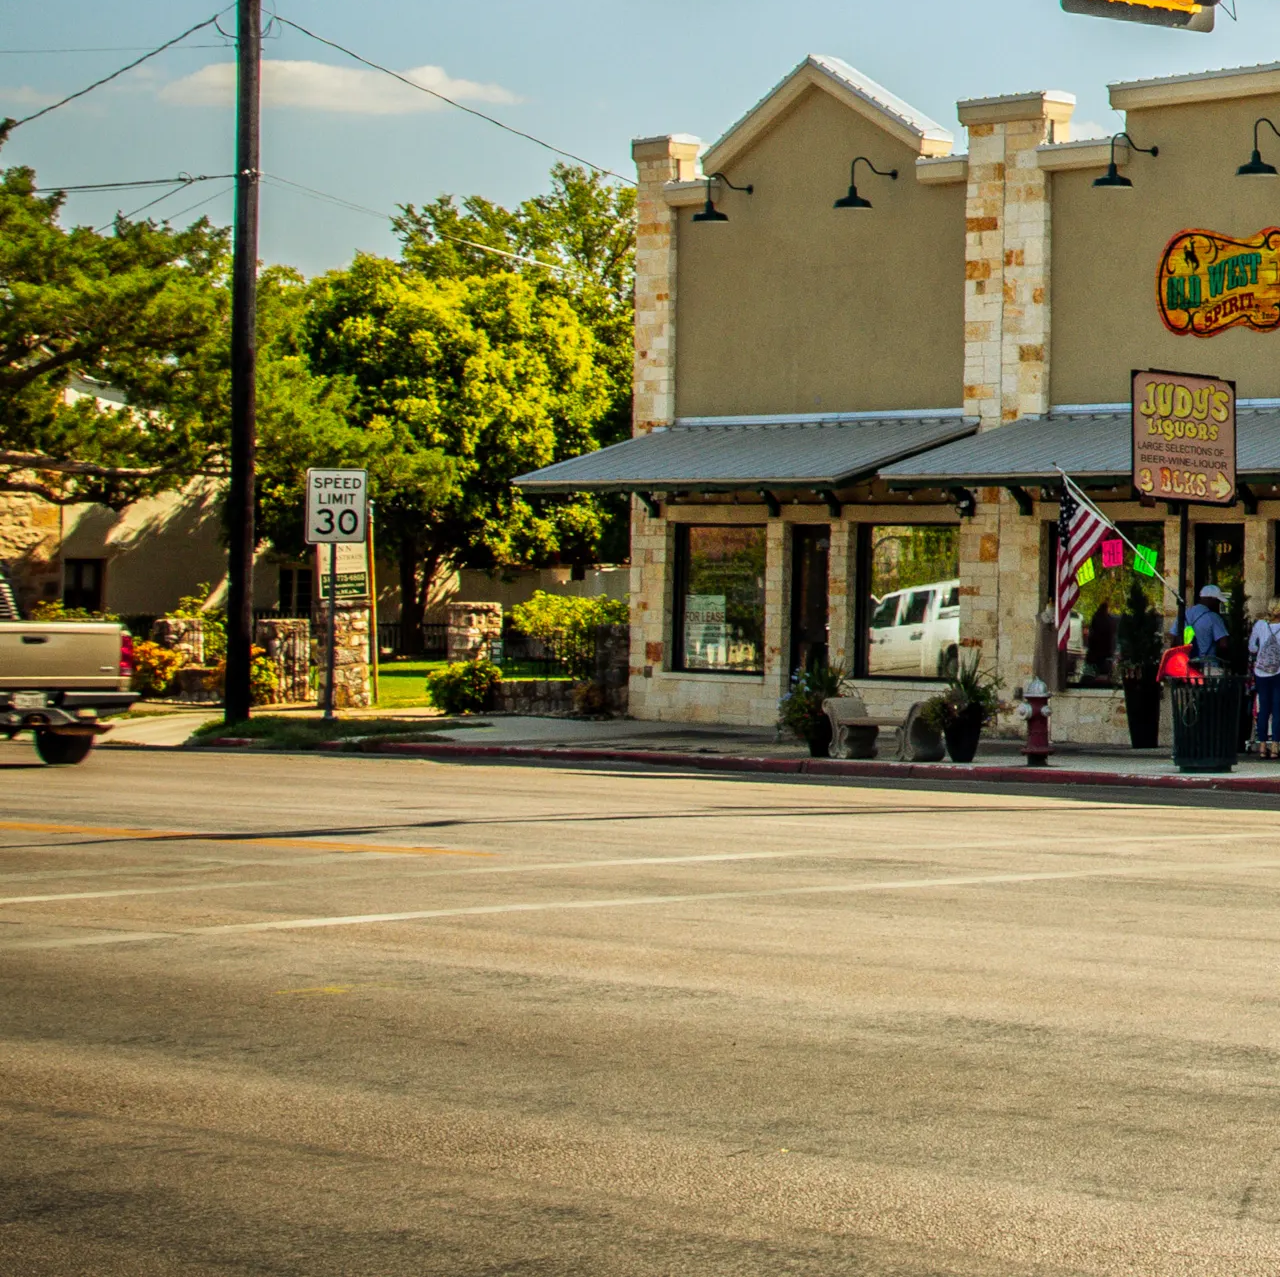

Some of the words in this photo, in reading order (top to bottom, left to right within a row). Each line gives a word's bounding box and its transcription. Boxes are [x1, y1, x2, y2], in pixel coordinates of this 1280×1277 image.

[1167, 275, 1201, 310] OLD
[1208, 252, 1262, 297] WEST
[1204, 292, 1254, 328] SPIRIT
[1140, 381, 1229, 422] JUDY'S
[1146, 418, 1219, 441] LIQUORS
[1137, 442, 1163, 452] LARGE
[1165, 444, 1213, 456] SELECTIONS
[1140, 454, 1228, 470] BEER-WINE-LIQUOR
[314, 477, 362, 489] SPEED
[1140, 468, 1154, 492] 3
[318, 493, 356, 504] LIMIT
[315, 508, 358, 535] 30
[1078, 558, 1094, 585] ALE
[685, 612, 700, 622] FOR
[702, 612, 725, 623] LEASE
